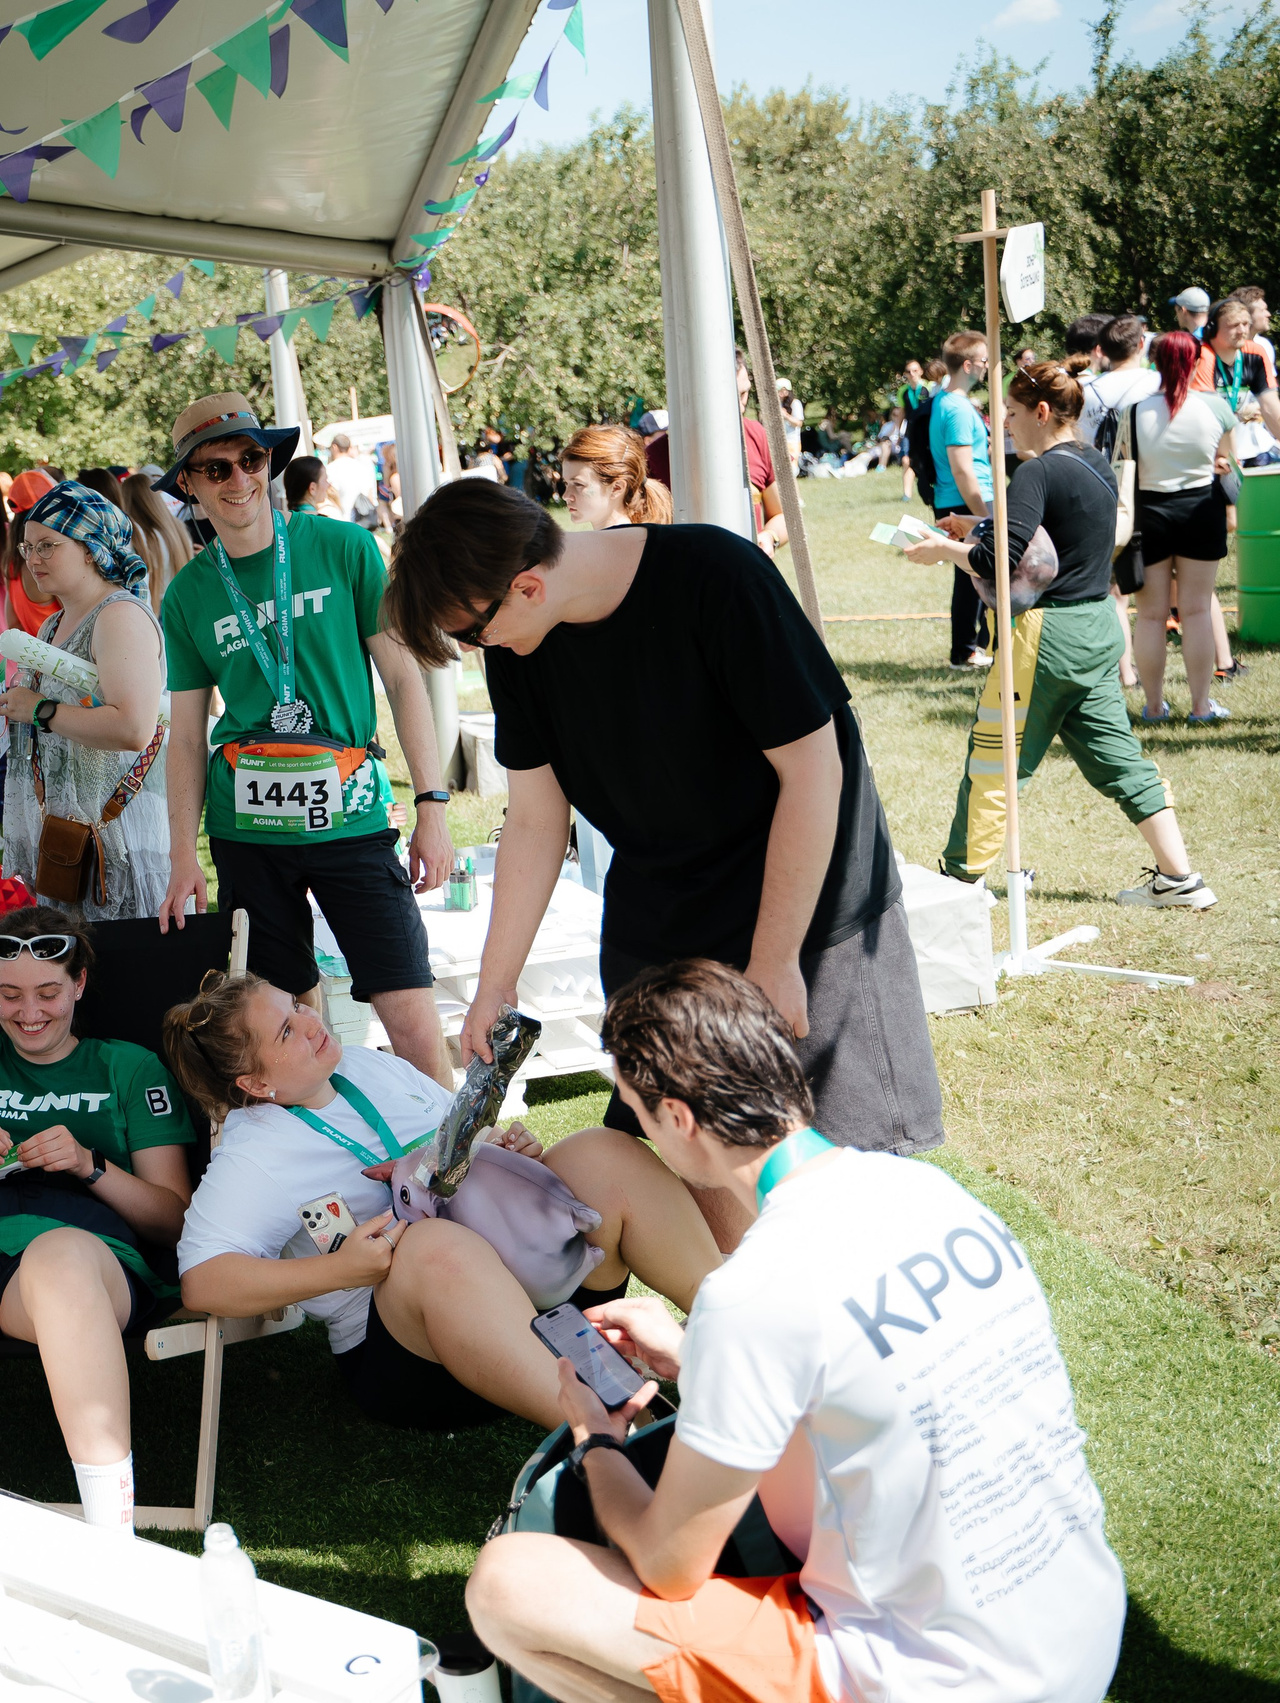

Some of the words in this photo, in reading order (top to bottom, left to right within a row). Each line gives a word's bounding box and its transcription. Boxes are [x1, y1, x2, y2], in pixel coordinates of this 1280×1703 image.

[277, 533, 286, 564] RUNIT
[240, 610, 255, 635] AGIMA
[280, 608, 288, 638] AGIMA
[283, 684, 291, 704] NIT
[275, 711, 293, 720] RUNIT
[240, 757, 265, 767] RUNIT
[286, 761, 299, 769] sport
[246, 779, 329, 807] 1443
[253, 817, 283, 827] AGIMA
[308, 806, 329, 829] B
[147, 1088, 169, 1116] B
[321, 1125, 355, 1147] RUNIT
[896, 1382, 906, 1392] В
[912, 1362, 937, 1381] ЧЕМ
[910, 1400, 933, 1416] МЫ
[944, 1500, 960, 1514] НА
[954, 1515, 989, 1540] СТАТЬ
[961, 1552, 977, 1567] НЕ
[970, 1583, 980, 1595] И
[976, 1598, 984, 1608] В
